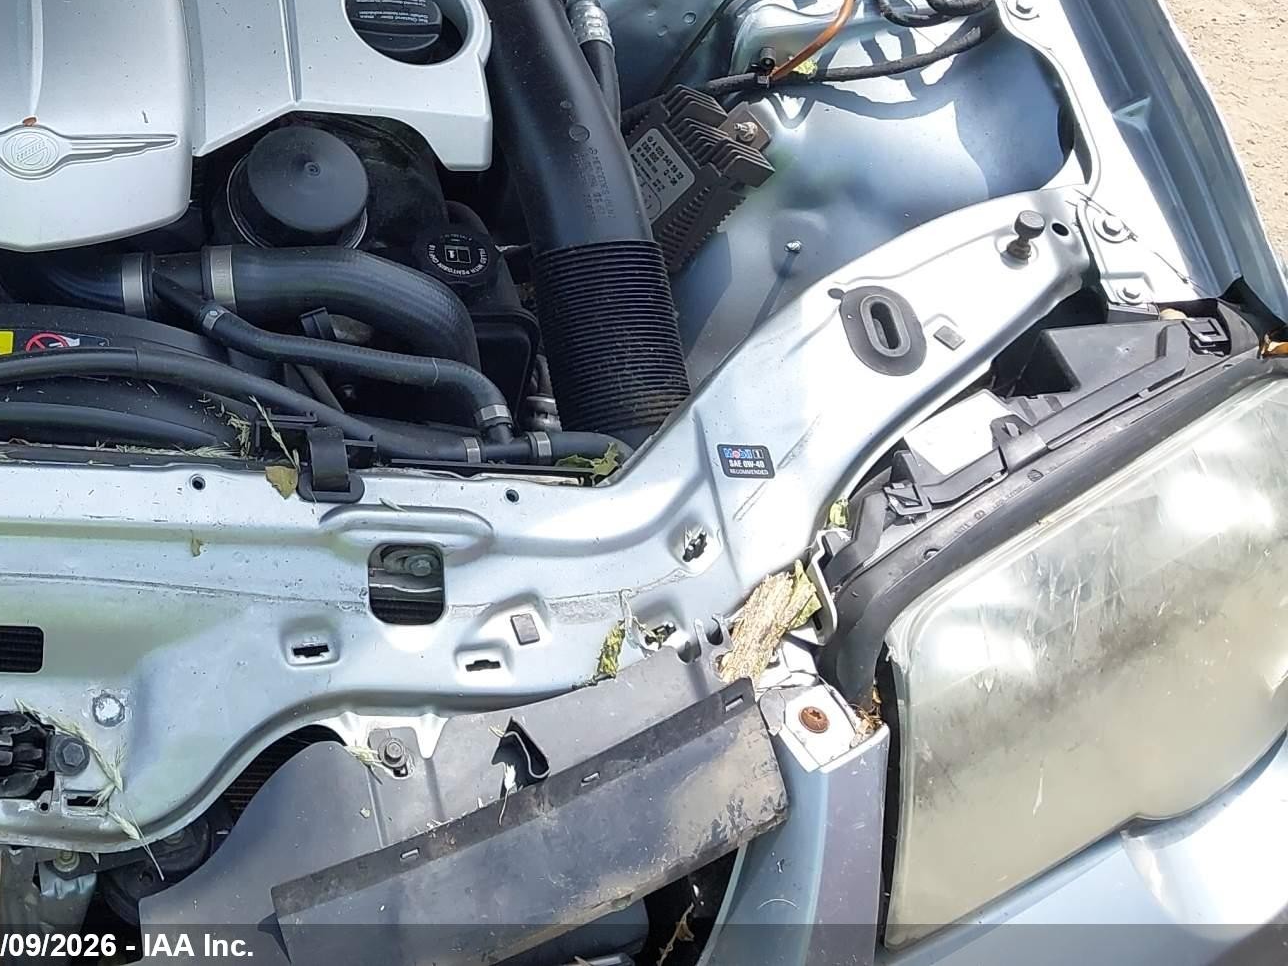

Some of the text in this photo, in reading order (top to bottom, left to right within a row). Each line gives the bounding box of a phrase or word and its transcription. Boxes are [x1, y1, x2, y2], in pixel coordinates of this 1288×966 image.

[723, 448, 752, 458] Mobil
[728, 460, 765, 468] SAE 0W-40
